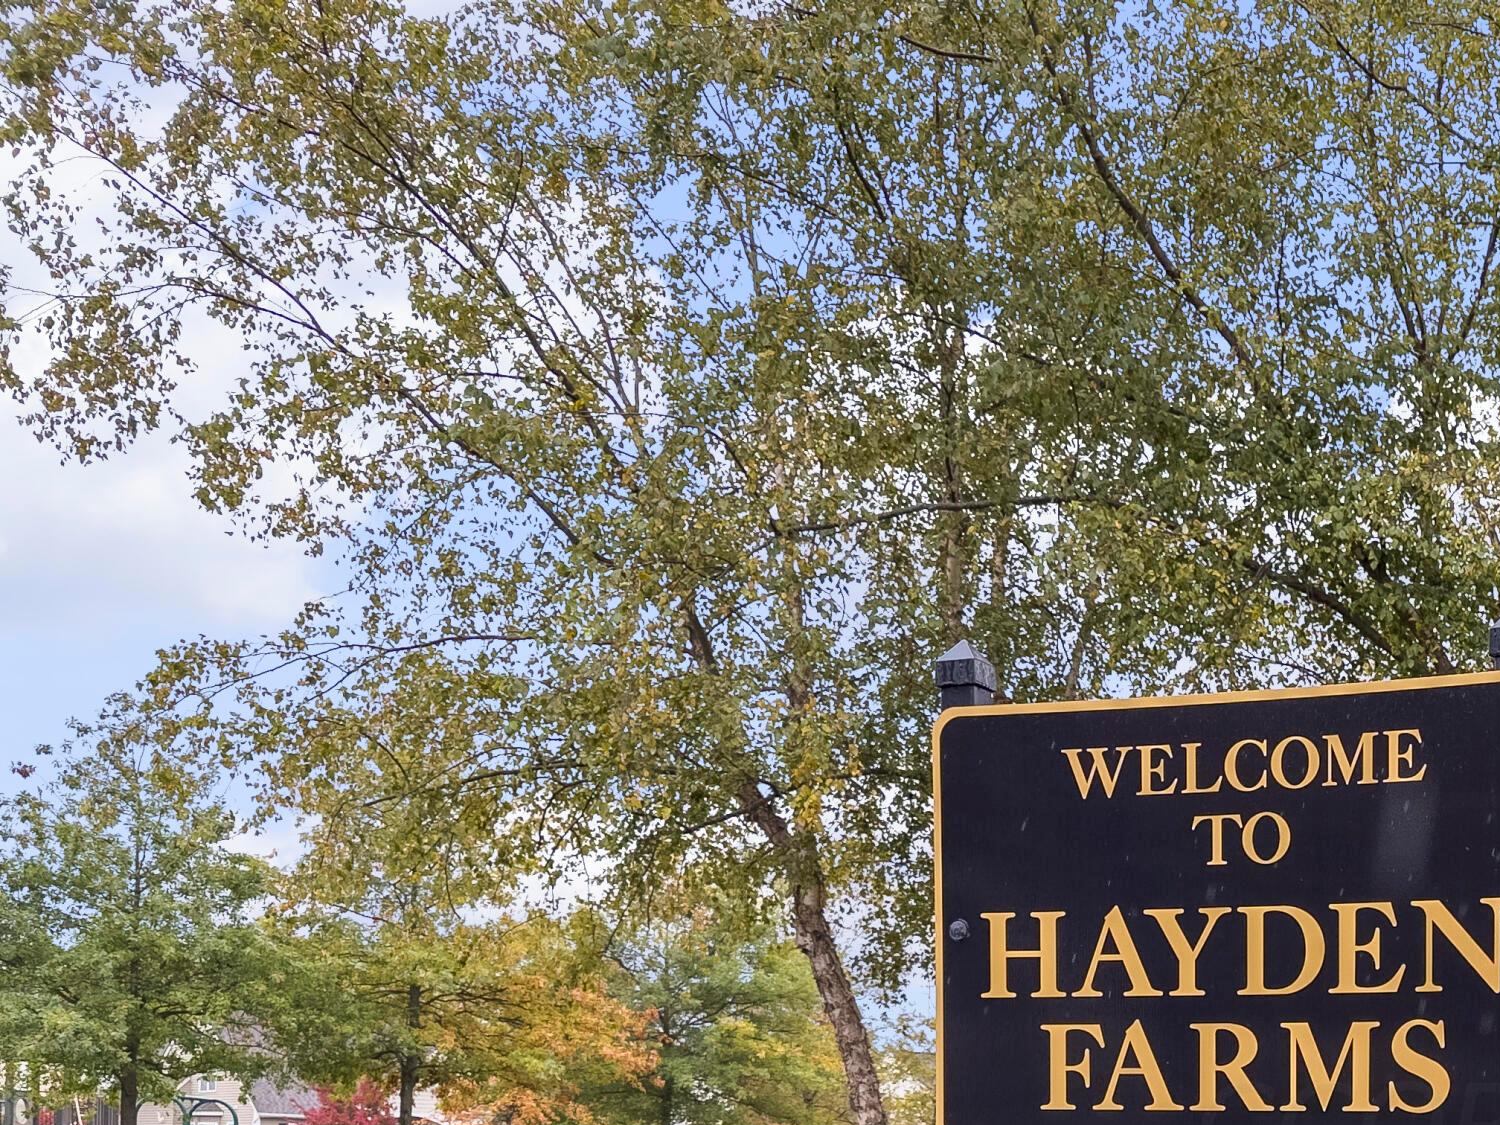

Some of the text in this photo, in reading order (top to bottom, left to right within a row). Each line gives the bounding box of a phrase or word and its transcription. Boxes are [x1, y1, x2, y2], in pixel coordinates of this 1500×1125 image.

[1061, 728, 1428, 799] WELCOME
[1191, 811, 1292, 866] TO
[1039, 1018, 1452, 1114] FARMS
